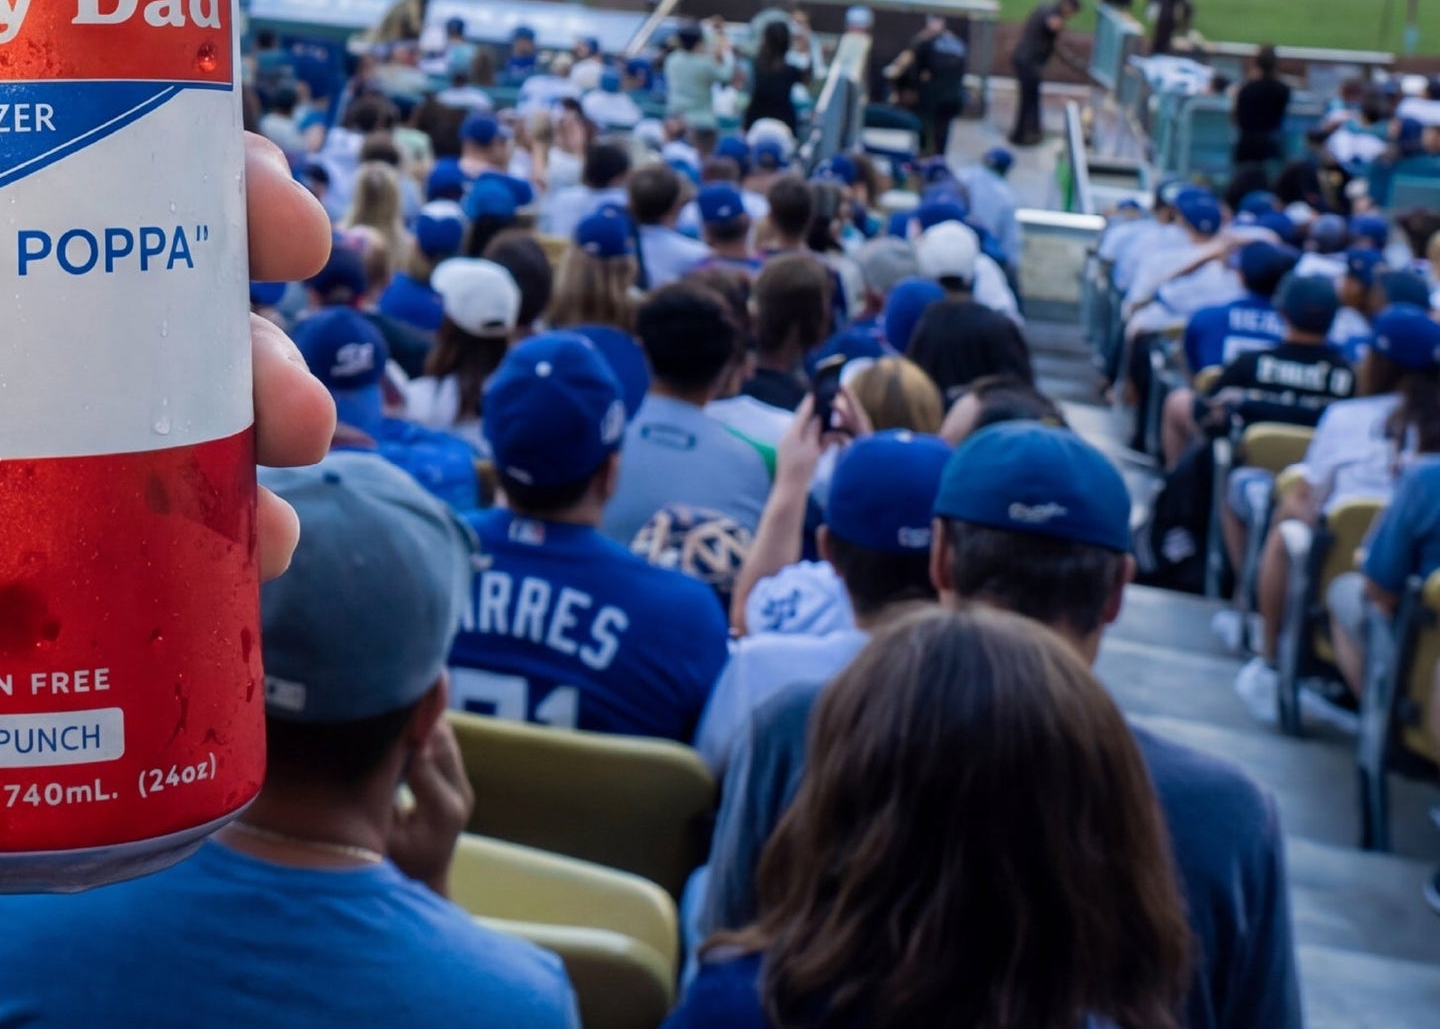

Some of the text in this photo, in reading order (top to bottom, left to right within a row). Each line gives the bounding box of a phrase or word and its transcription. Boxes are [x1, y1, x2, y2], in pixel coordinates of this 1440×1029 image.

[17, 224, 210, 278] POPPA”
[30, 667, 111, 695] FREE
[2, 778, 119, 808] 740mL.
[137, 751, 218, 799] (24oz)
